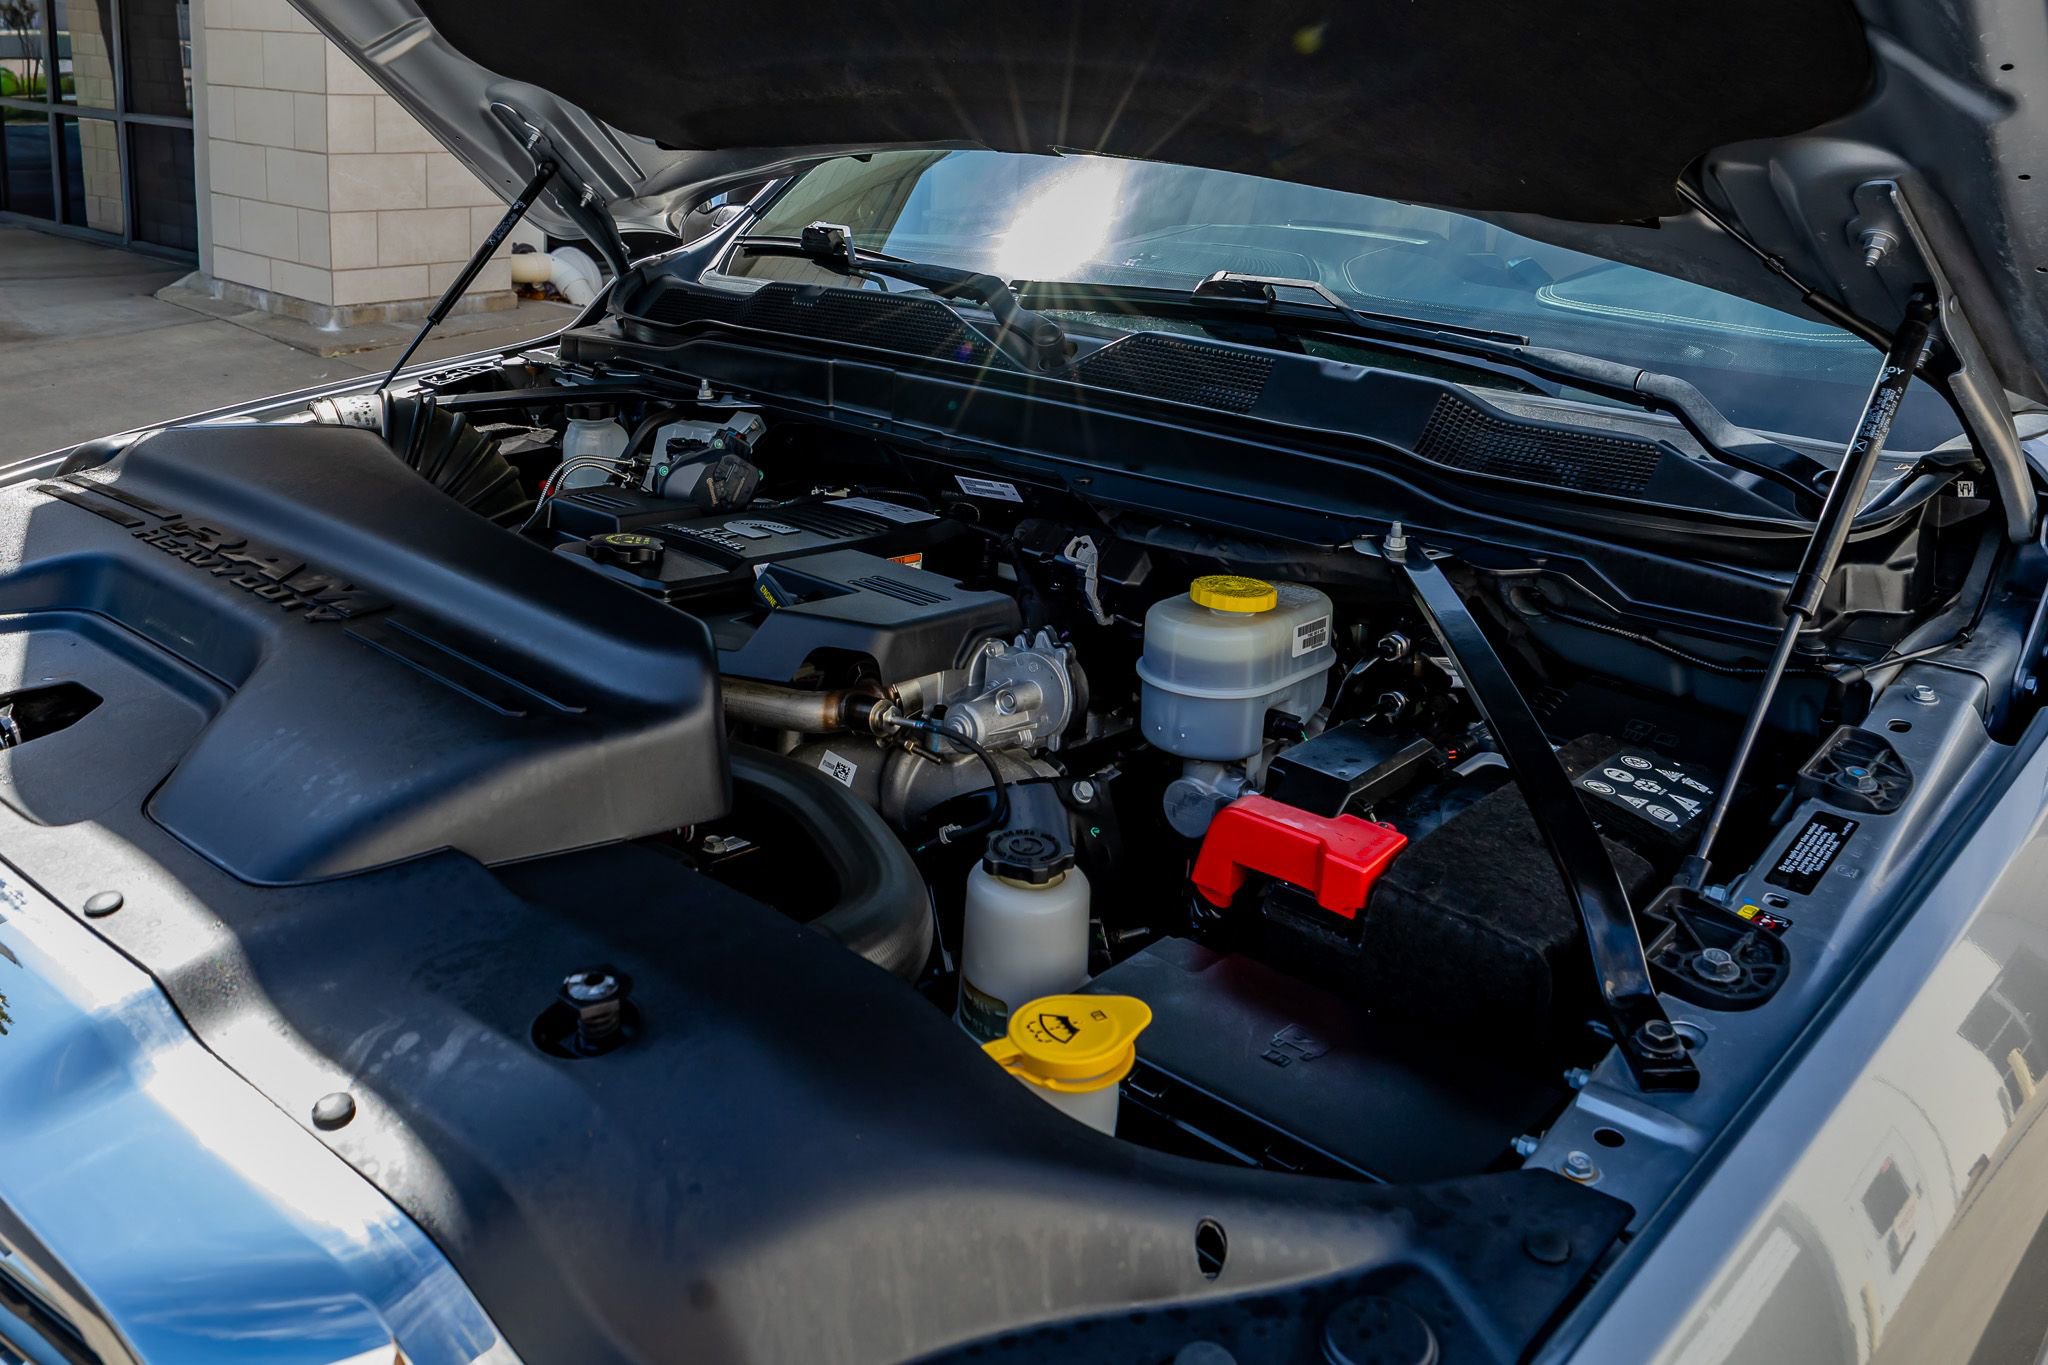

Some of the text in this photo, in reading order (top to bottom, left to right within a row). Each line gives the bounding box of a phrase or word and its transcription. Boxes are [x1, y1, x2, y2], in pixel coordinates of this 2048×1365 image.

[131, 529, 343, 623] HEAVY DUTY
[160, 518, 394, 619] RAM
